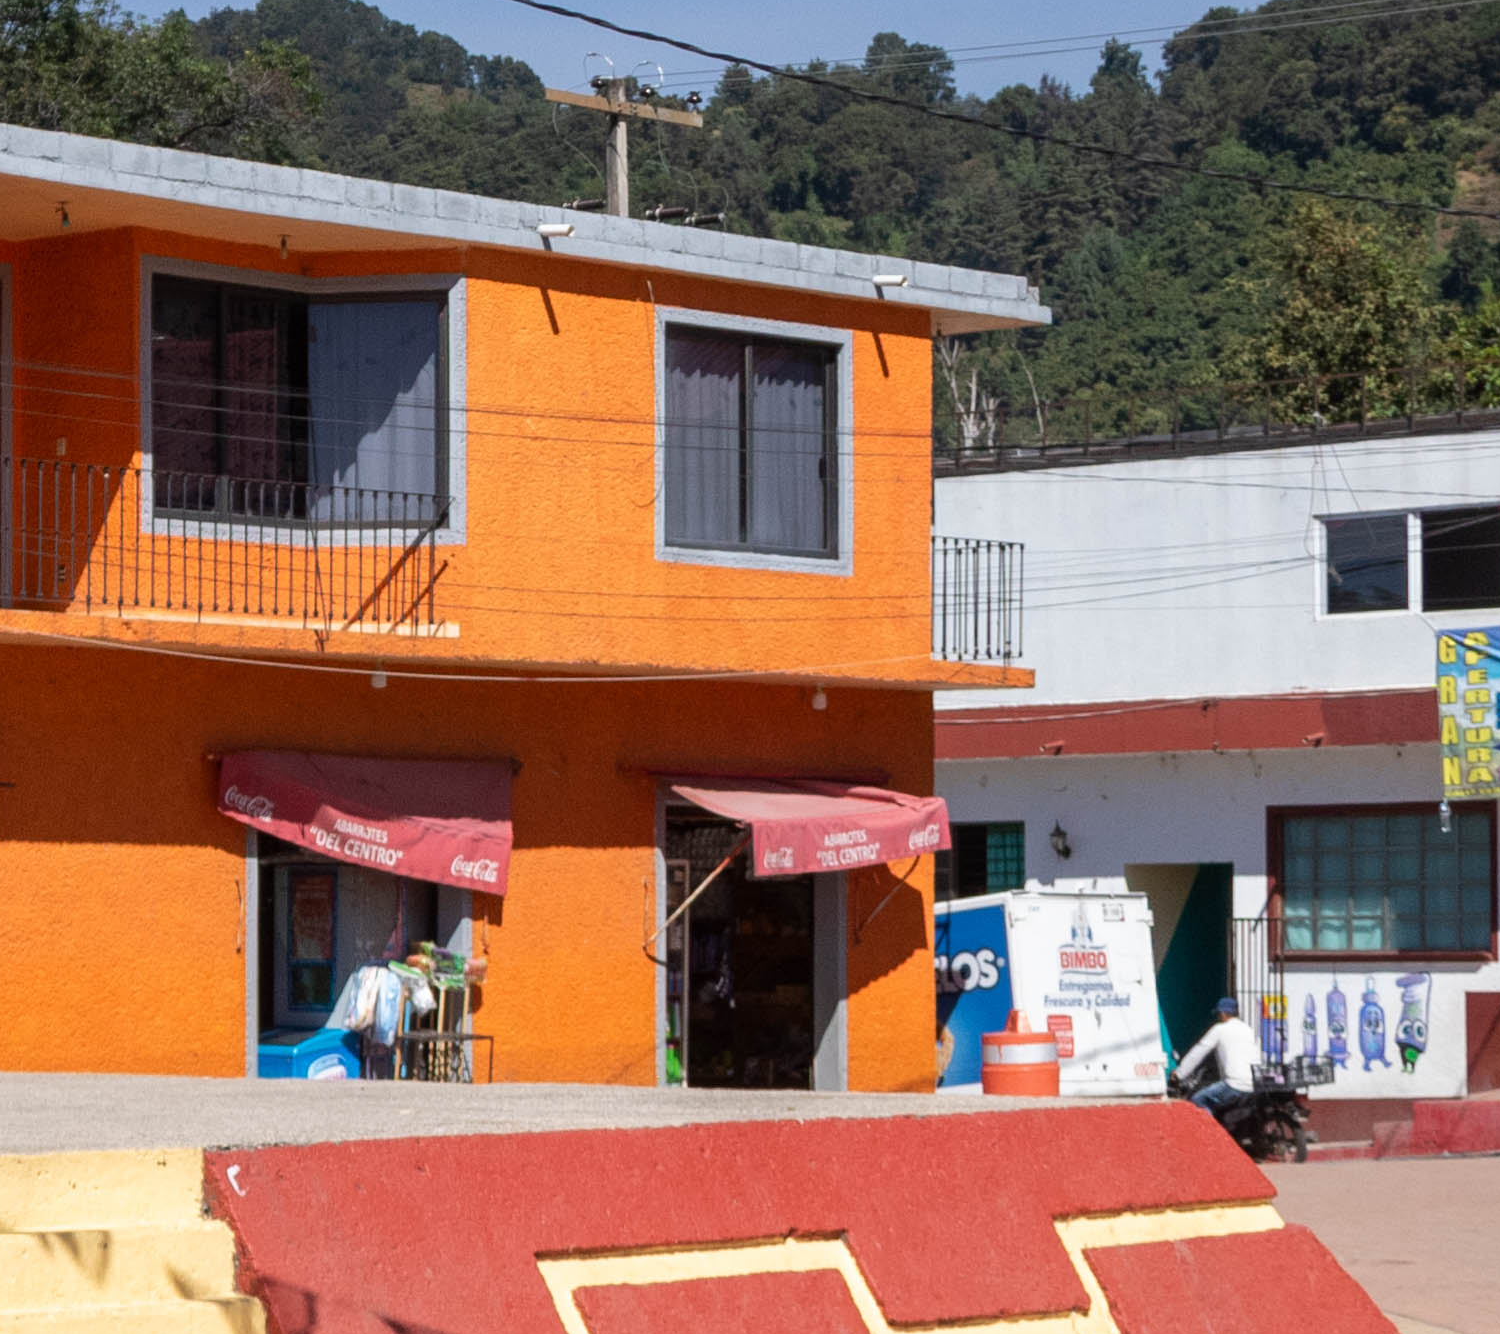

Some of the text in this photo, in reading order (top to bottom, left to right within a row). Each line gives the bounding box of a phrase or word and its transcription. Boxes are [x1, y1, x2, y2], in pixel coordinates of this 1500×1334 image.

[334, 818, 388, 844] ABARROTES
[1059, 951, 1108, 969] BIMBO
[1095, 992, 1131, 1008] Calidad
